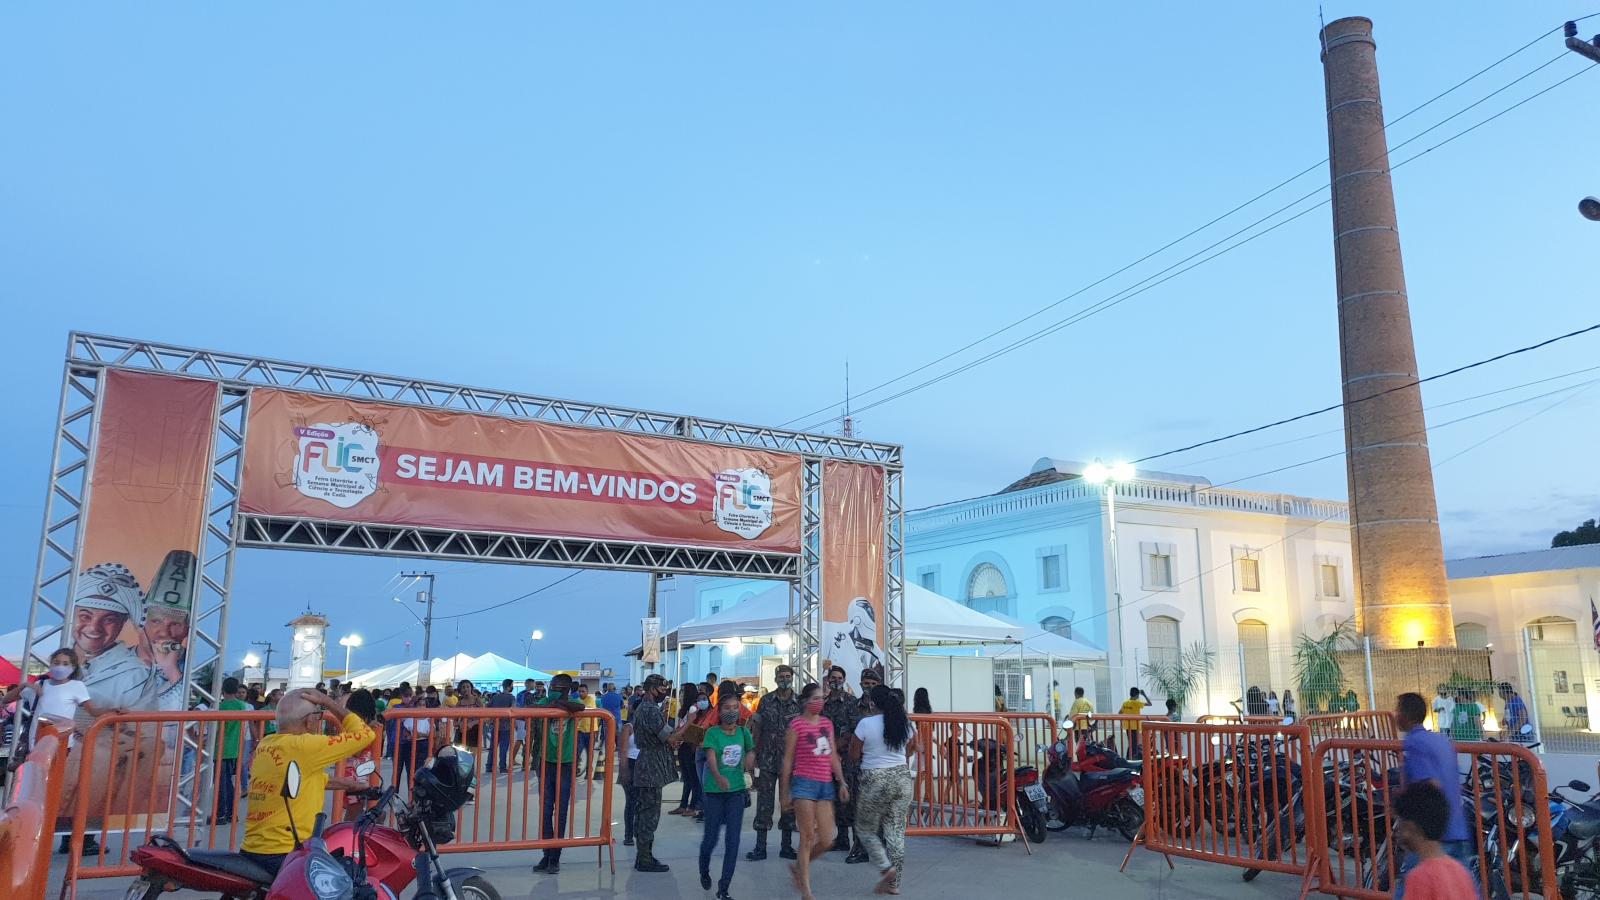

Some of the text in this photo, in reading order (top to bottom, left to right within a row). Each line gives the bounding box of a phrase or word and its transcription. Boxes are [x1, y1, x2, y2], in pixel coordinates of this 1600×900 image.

[306, 429, 329, 438] Edição
[352, 455, 375, 464] SMCT
[396, 454, 697, 505] SEJAM BEM-VINDOS
